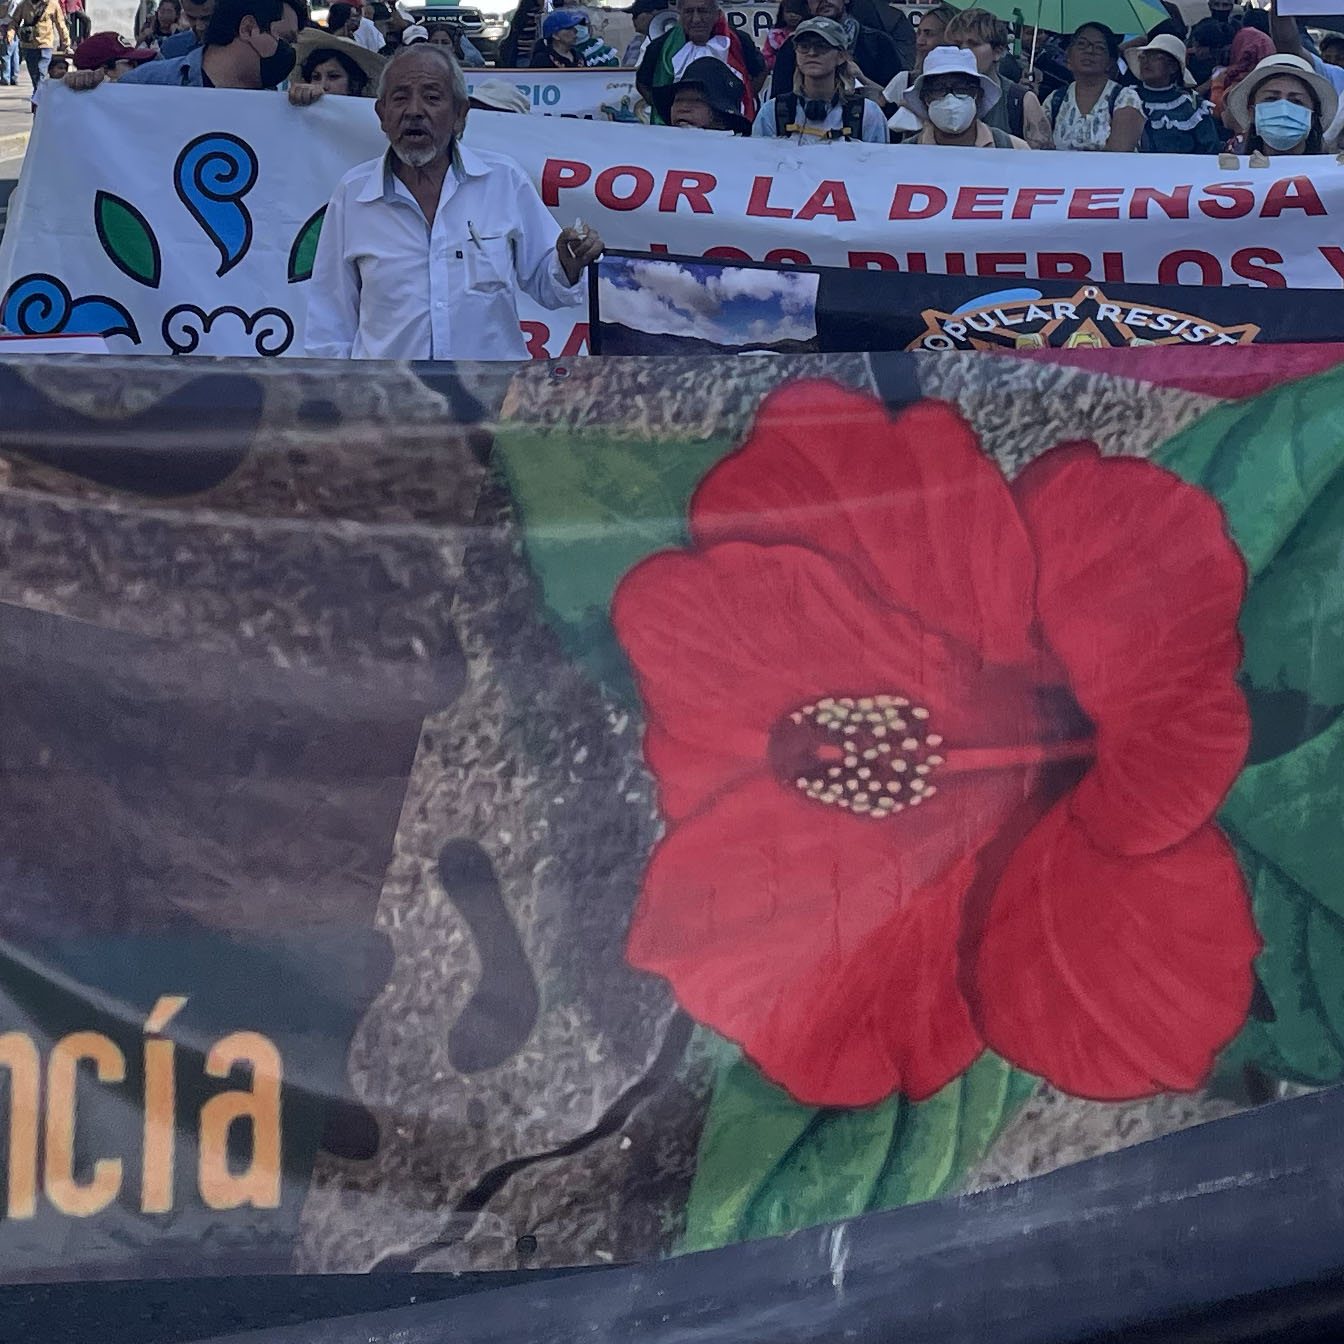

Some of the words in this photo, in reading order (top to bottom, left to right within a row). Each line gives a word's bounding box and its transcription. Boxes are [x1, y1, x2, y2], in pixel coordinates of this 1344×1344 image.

[542, 159, 717, 213] POR
[746, 175, 856, 222] LA
[888, 175, 1328, 221] DEFENSA
[923, 302, 1079, 351] OPULAR
